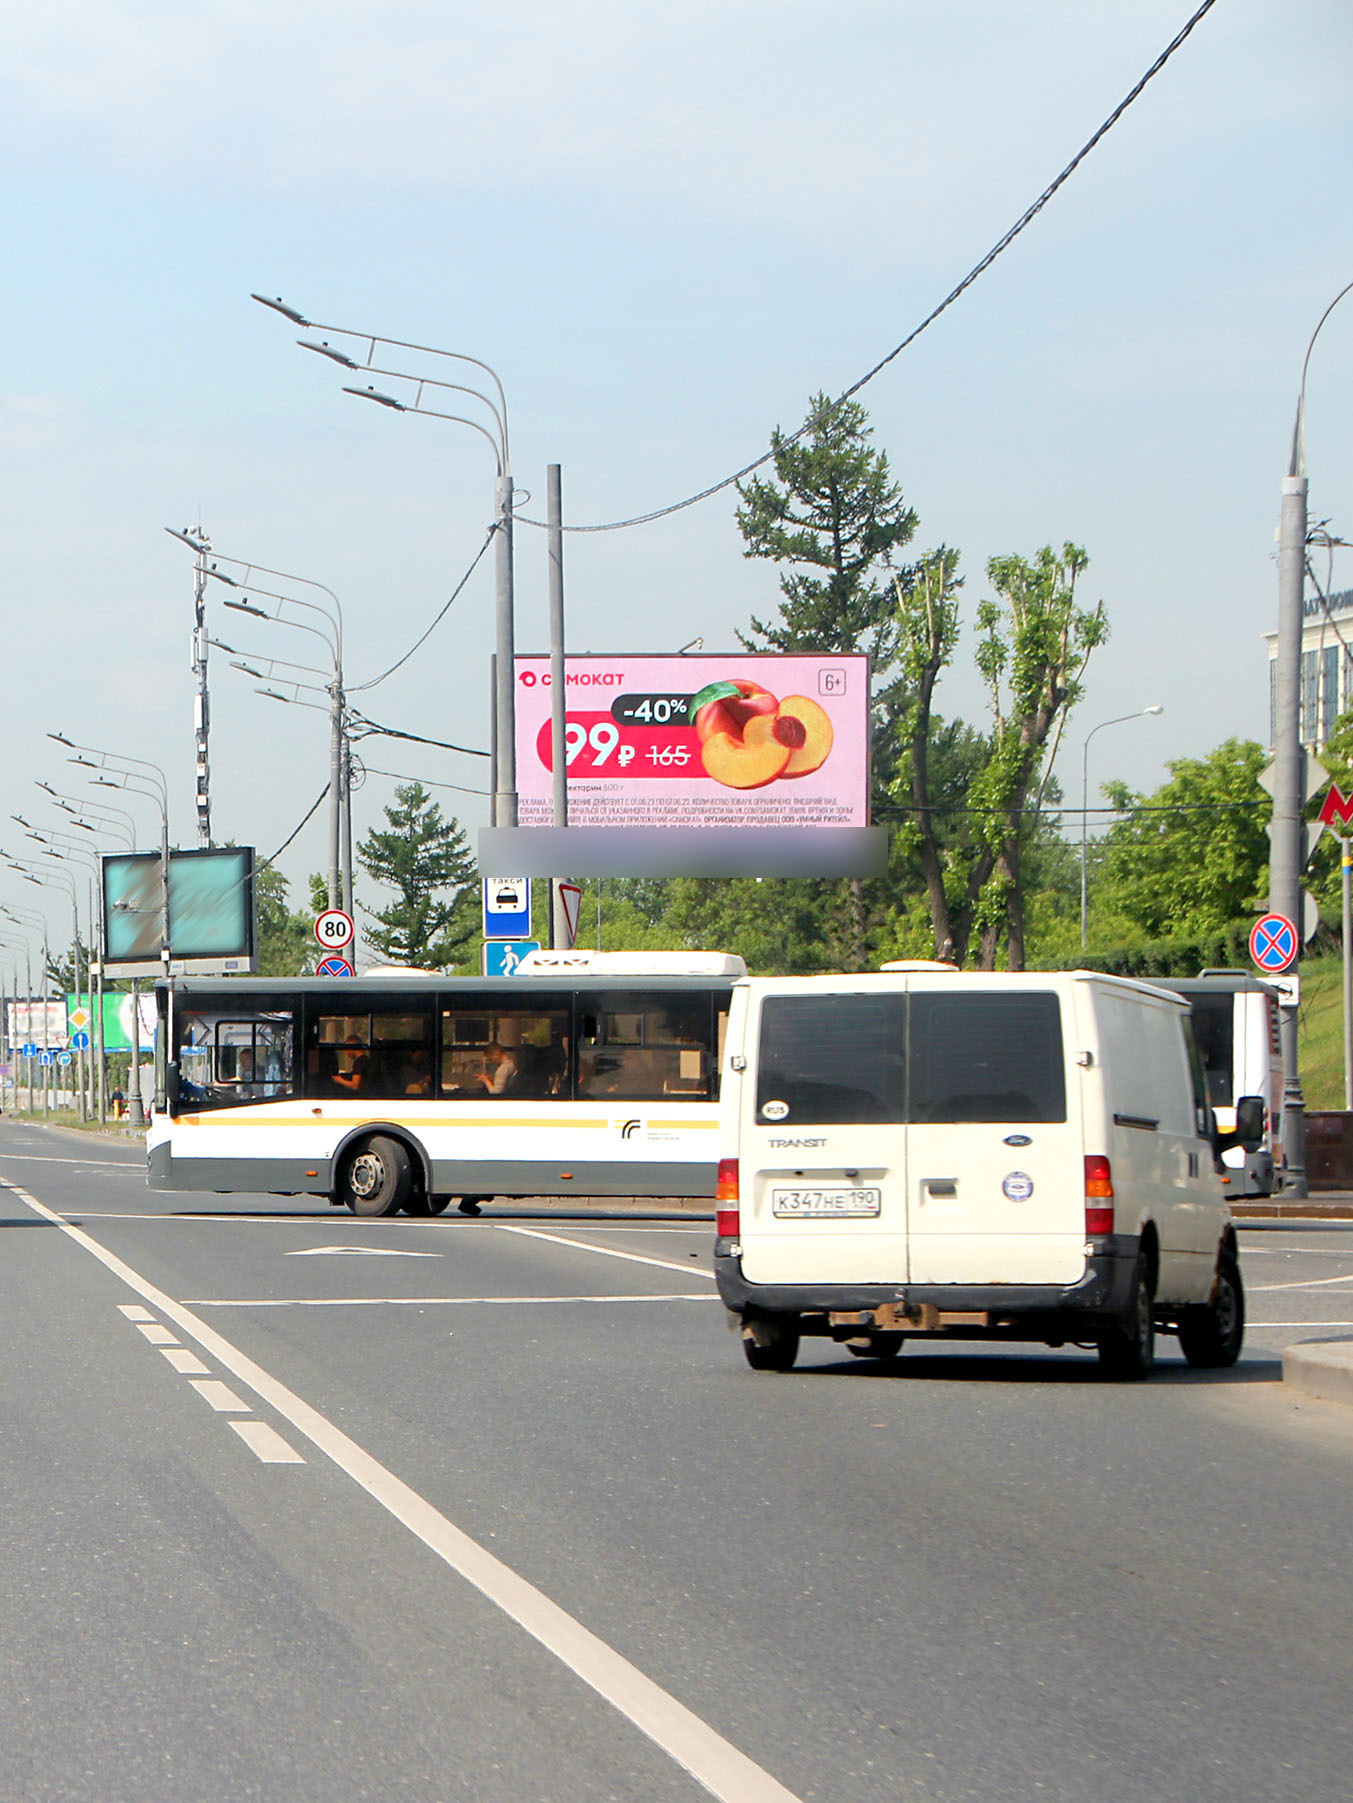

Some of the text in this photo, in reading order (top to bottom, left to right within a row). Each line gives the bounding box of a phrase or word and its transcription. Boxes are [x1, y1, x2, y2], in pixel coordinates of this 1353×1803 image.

[541, 673, 625, 686] смокат
[825, 673, 842, 692] 6+
[623, 698, 688, 723] -40%
[646, 745, 691, 766] 165
[325, 921, 346, 938] 80
[768, 1138, 827, 1148] TRANSIT
